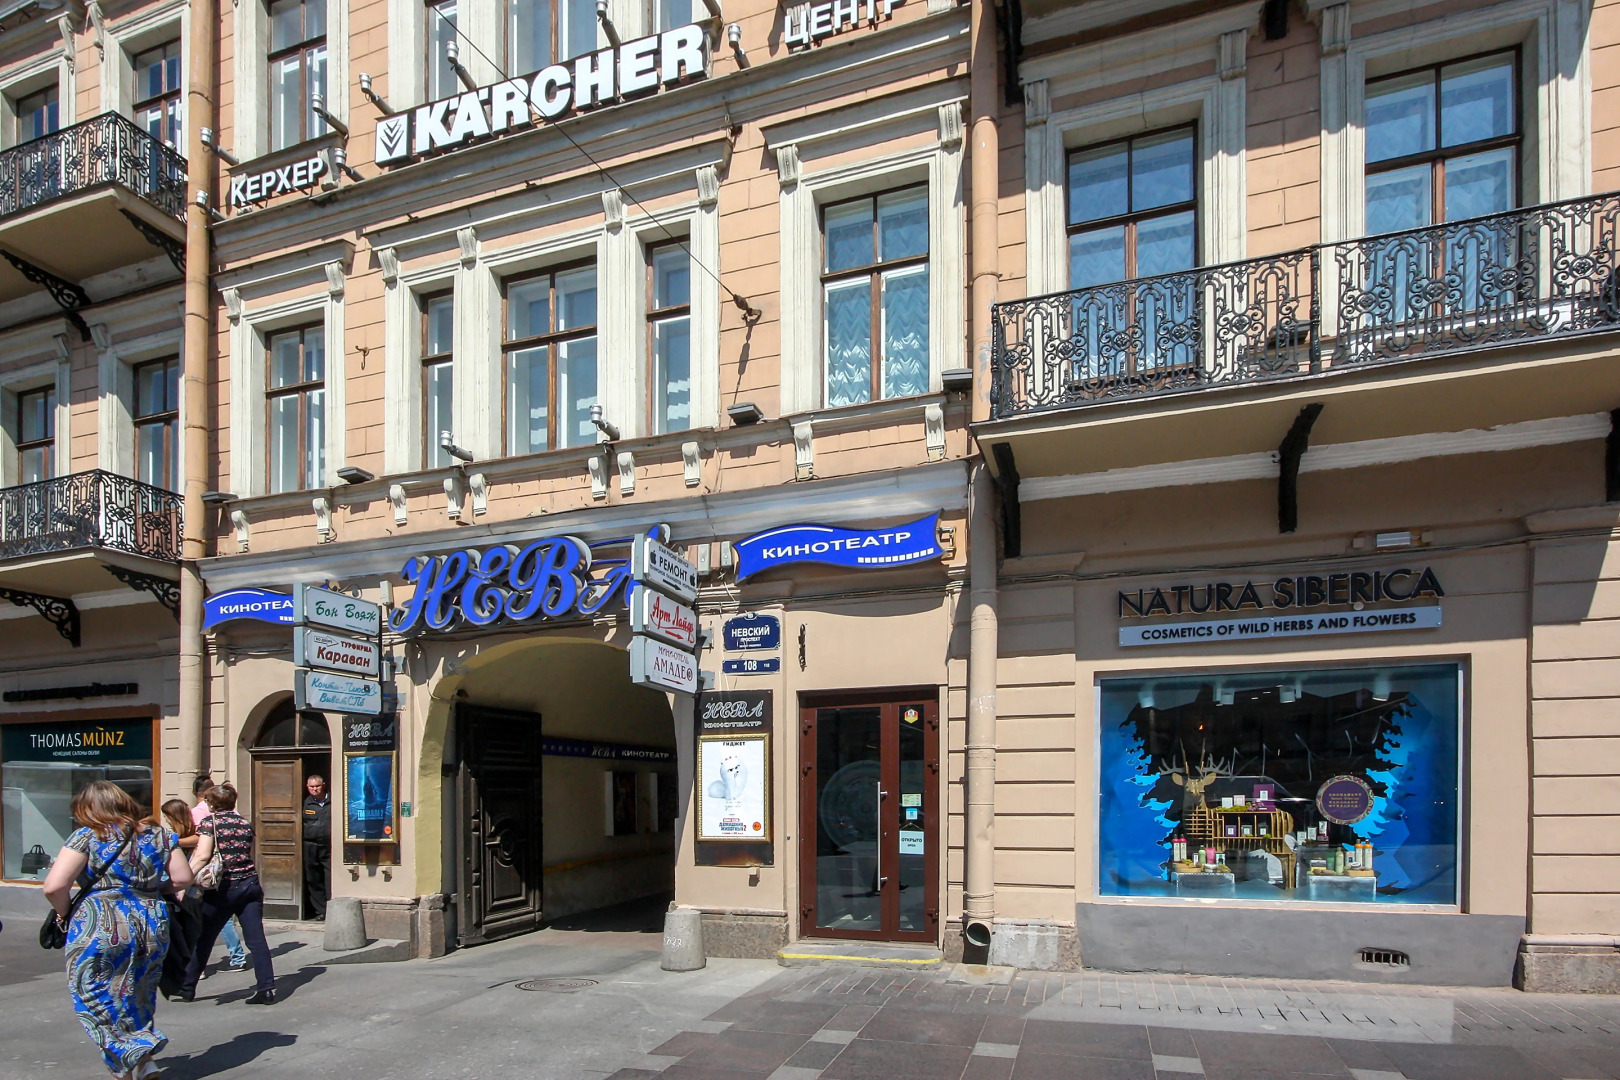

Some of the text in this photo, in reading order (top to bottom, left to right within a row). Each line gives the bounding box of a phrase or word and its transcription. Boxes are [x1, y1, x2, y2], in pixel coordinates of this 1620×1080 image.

[415, 24, 705, 154] KÄRCHER
[230, 158, 325, 206] КЕРХЕР
[762, 531, 912, 559] КИНОТЕАТР
[659, 556, 688, 581] РЕМОНТ
[1118, 566, 1445, 618] NATURA SIBERICA
[220, 600, 295, 615] КИНОТЕА
[315, 601, 377, 622] Бон Вояж
[651, 596, 694, 643] Арт Лайф
[1141, 612, 1417, 641] COSMETICS OF WILD HERBS AND FLOWERS
[731, 625, 770, 637] НЕВСКИЙ
[317, 646, 371, 667] Караван
[341, 641, 373, 653] ТУРФИРМА
[743, 660, 757, 671] 108
[702, 700, 764, 719] НЕВА
[348, 722, 394, 738] НЕВА
[703, 720, 763, 729] КИНОТЕАТР
[30, 732, 82, 748] THOMAS
[621, 749, 670, 759] КИНОТЕАТР
